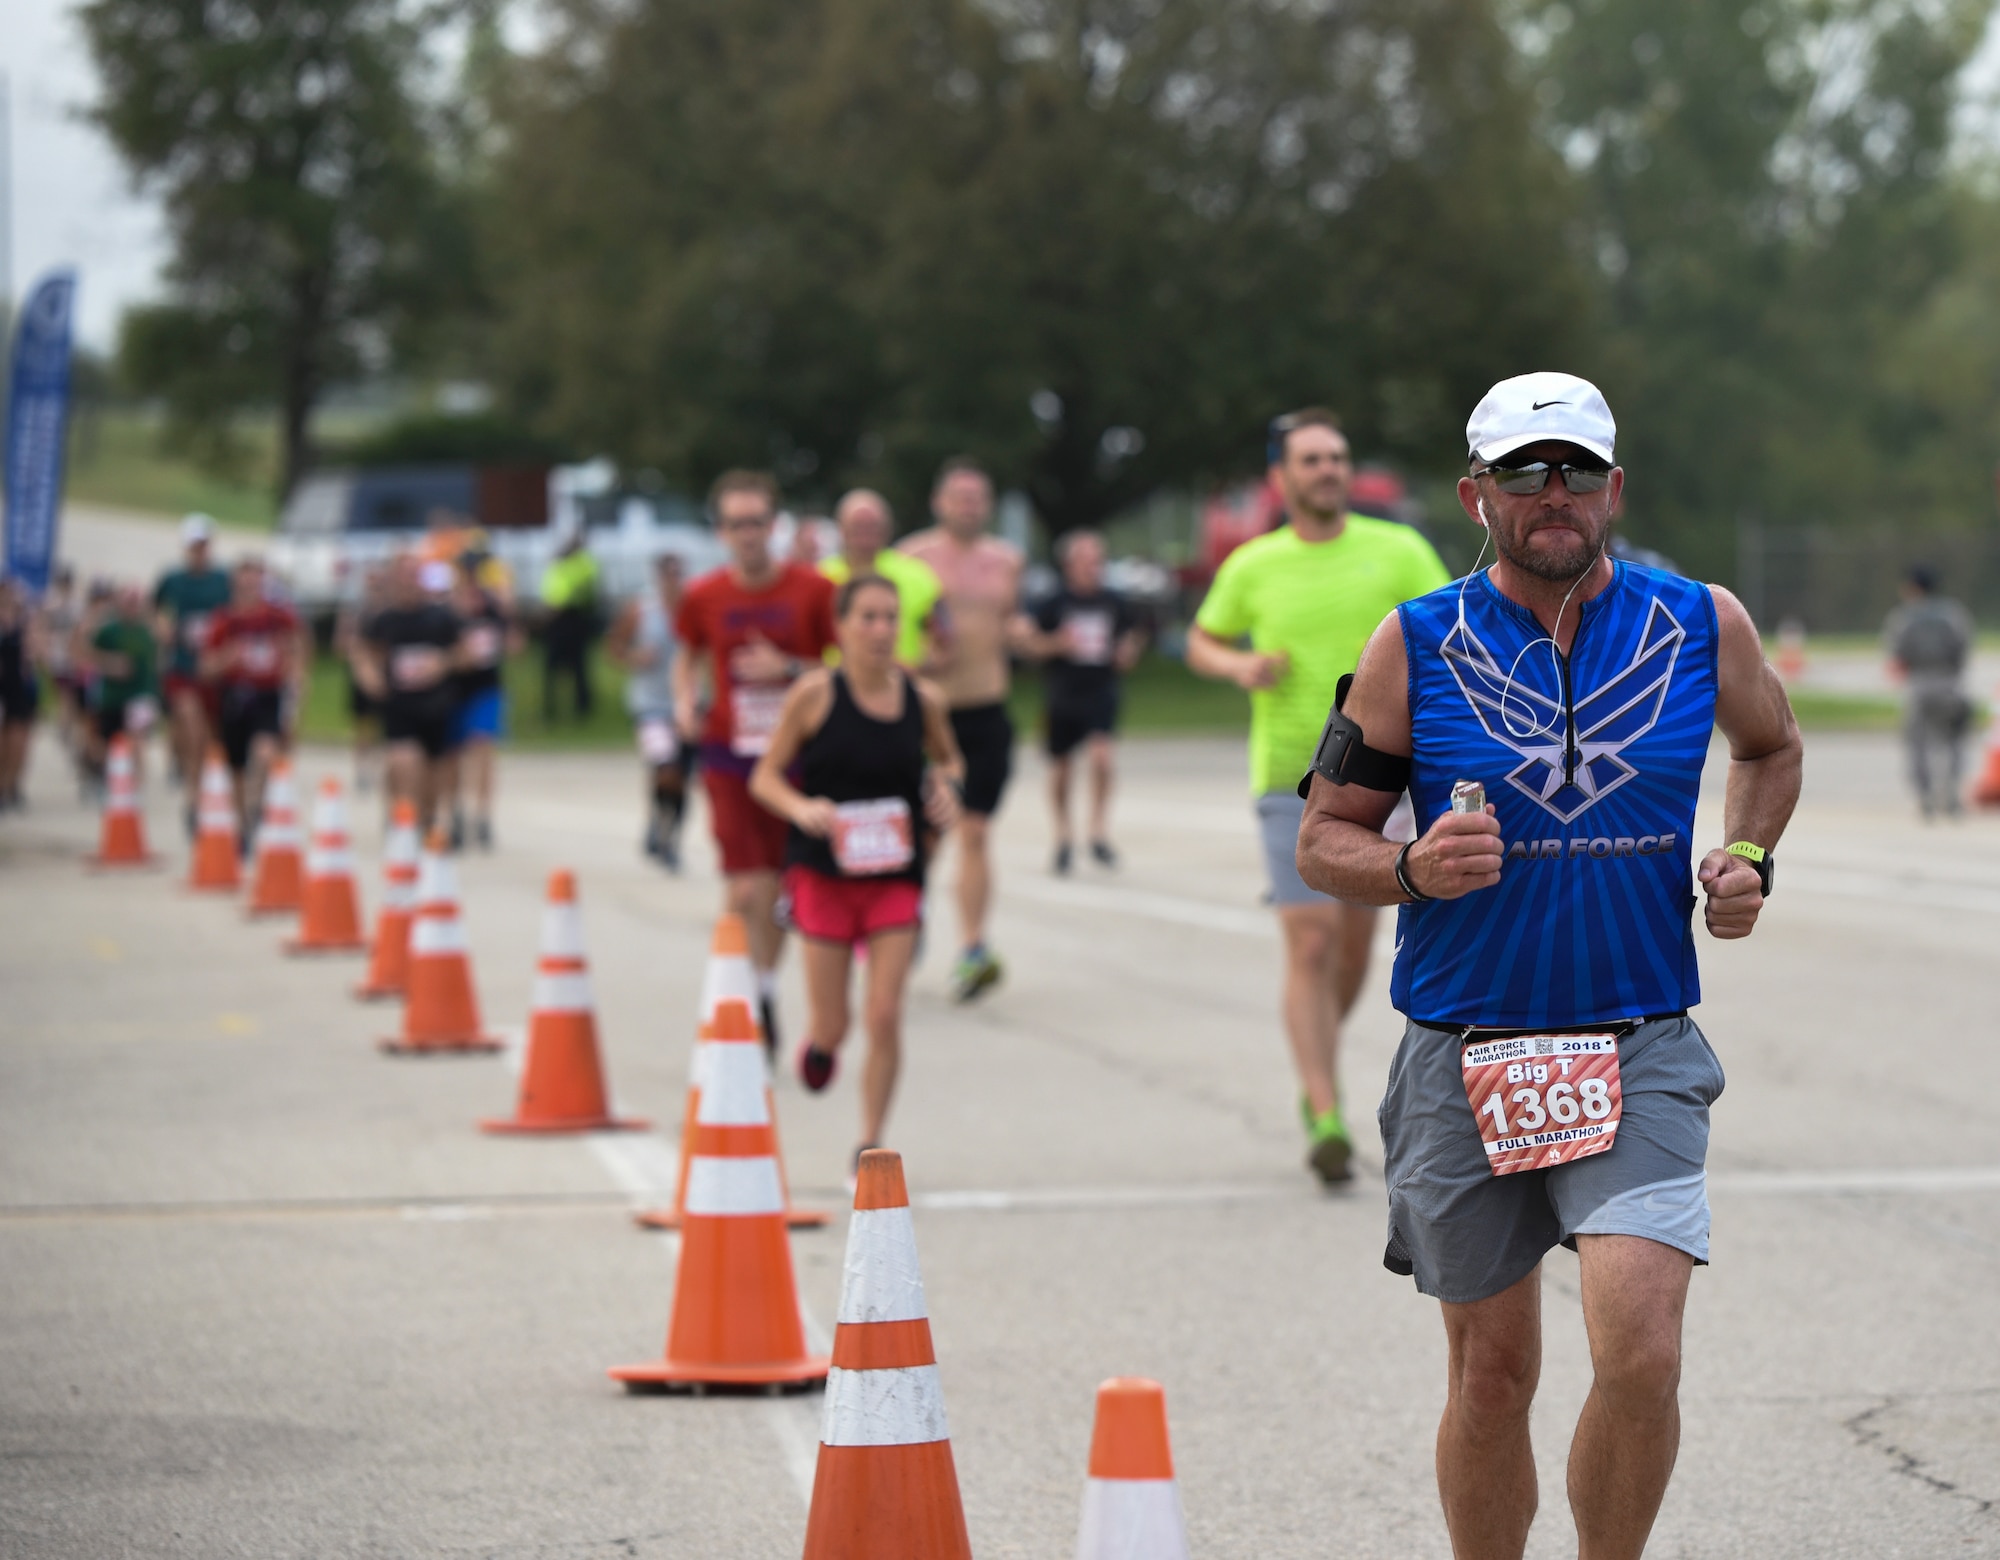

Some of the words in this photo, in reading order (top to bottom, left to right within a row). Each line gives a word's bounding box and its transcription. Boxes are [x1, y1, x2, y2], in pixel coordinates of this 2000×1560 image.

[1506, 838, 1562, 860] AIR
[1568, 833, 1676, 859] FORCE
[1473, 1046, 1490, 1056] AIR
[1493, 1041, 1526, 1053] FORCE
[1473, 1048, 1527, 1064] MARATHON
[1561, 1042, 1601, 1051] 2018
[1506, 1061, 1549, 1084] Big
[1555, 1058, 1574, 1076] T
[1481, 1077, 1612, 1135] 1368
[1497, 1137, 1531, 1151] FULL
[1535, 1125, 1604, 1145] MARATHON
